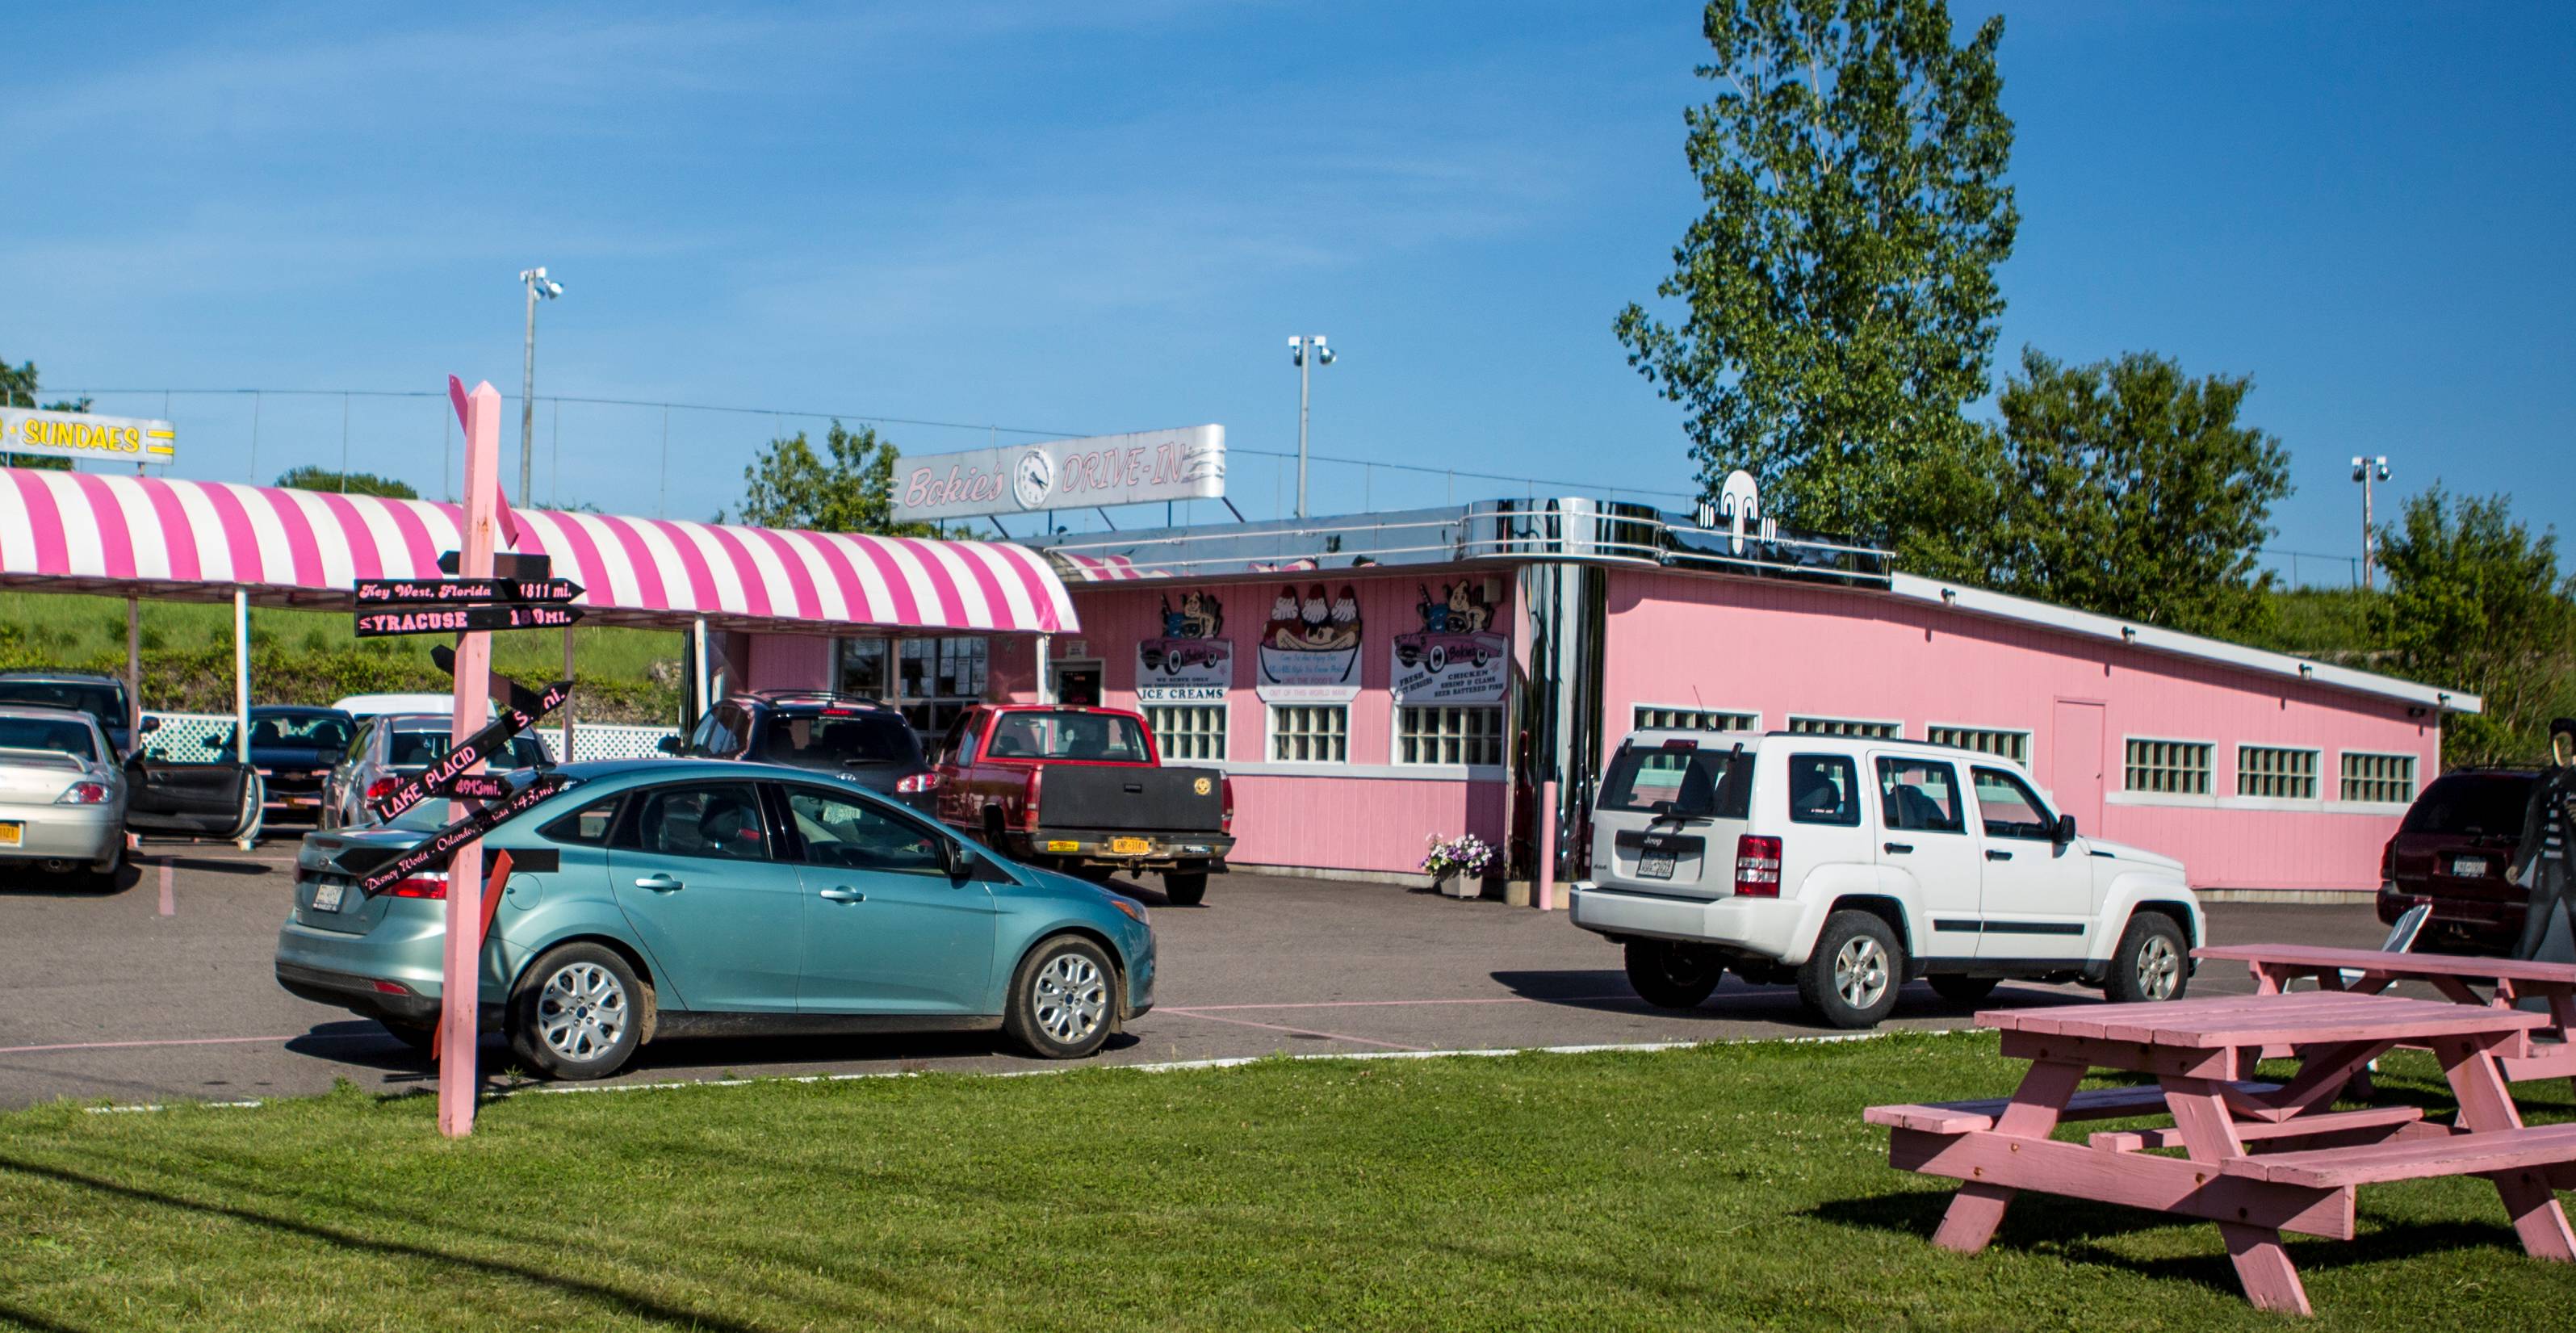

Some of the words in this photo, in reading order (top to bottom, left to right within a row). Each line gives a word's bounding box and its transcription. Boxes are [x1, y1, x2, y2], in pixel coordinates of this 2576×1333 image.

[23, 417, 140, 453] SUNDAES
[903, 461, 1005, 509] Bokie's
[1062, 442, 1187, 493] DRIVE-IN
[358, 584, 391, 600] Key
[395, 584, 434, 598] West,
[438, 584, 492, 598] Florida
[520, 583, 549, 598] 1811
[553, 582, 572, 598] mi.
[1399, 672, 1424, 686] FRESH
[1447, 670, 1488, 680] CHICKEN
[1440, 680, 1464, 689] SHRIMP
[1474, 676, 1496, 685] CLAMS
[1142, 689, 1163, 699] ICE
[1170, 689, 1223, 699] CREAMS
[1270, 689, 1281, 697] OUT
[1284, 688, 1291, 697] OF
[1293, 688, 1306, 697] THIS
[1309, 689, 1330, 697] WORLD
[1434, 690, 1450, 698] BEER
[1452, 685, 1486, 695] BATTERED
[1489, 683, 1504, 691] FISH
[382, 782, 424, 820] LAKE
[425, 746, 476, 790] PLACID
[1644, 836, 1662, 847] Jeep
[365, 870, 398, 891] Disney
